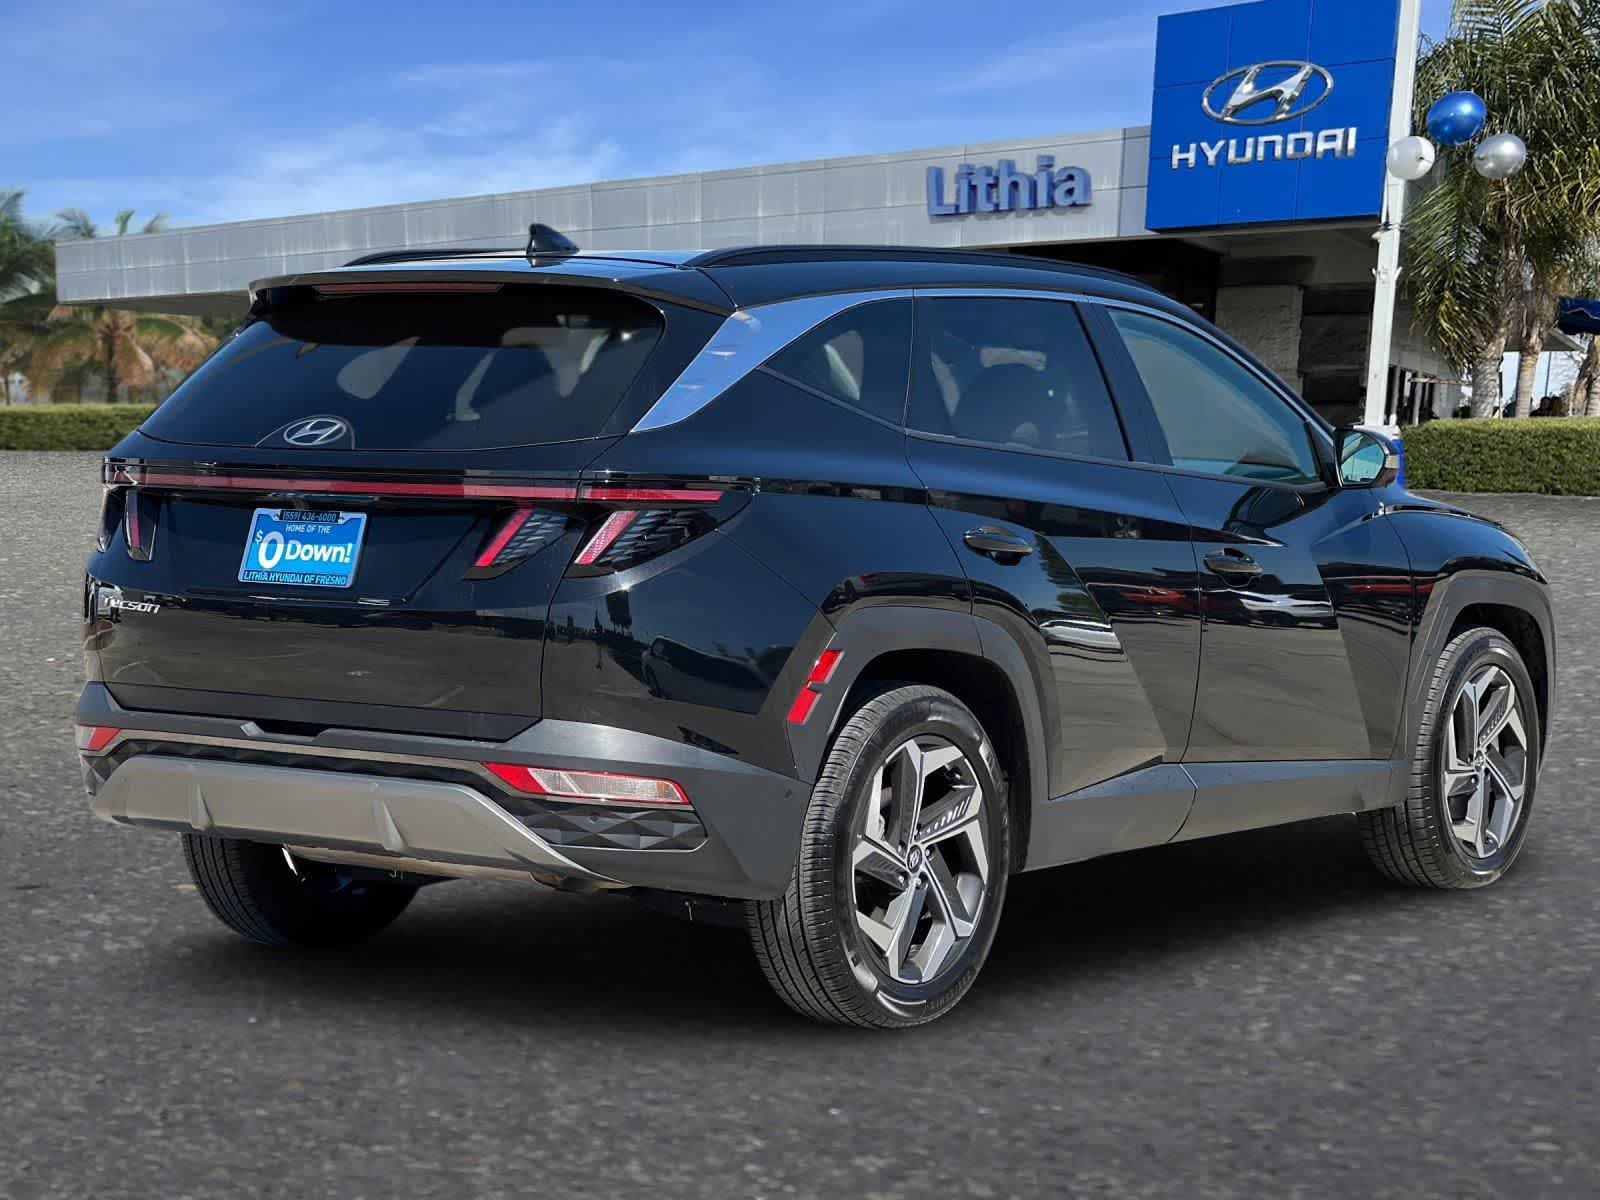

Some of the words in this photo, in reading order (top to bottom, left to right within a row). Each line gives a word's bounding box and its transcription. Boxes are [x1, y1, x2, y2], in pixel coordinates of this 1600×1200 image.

[1171, 127, 1357, 169] HYUNDAI
[926, 154, 1092, 217] Lithia
[302, 511, 337, 522] 436-6000
[286, 524, 305, 533] HOME
[307, 525, 316, 533] OF
[318, 525, 332, 534] THE
[285, 540, 353, 563] Down!
[244, 571, 268, 581] LITHIA
[269, 572, 304, 583] HYUNDAI
[304, 574, 315, 584] OF
[315, 575, 346, 585] FRESNO
